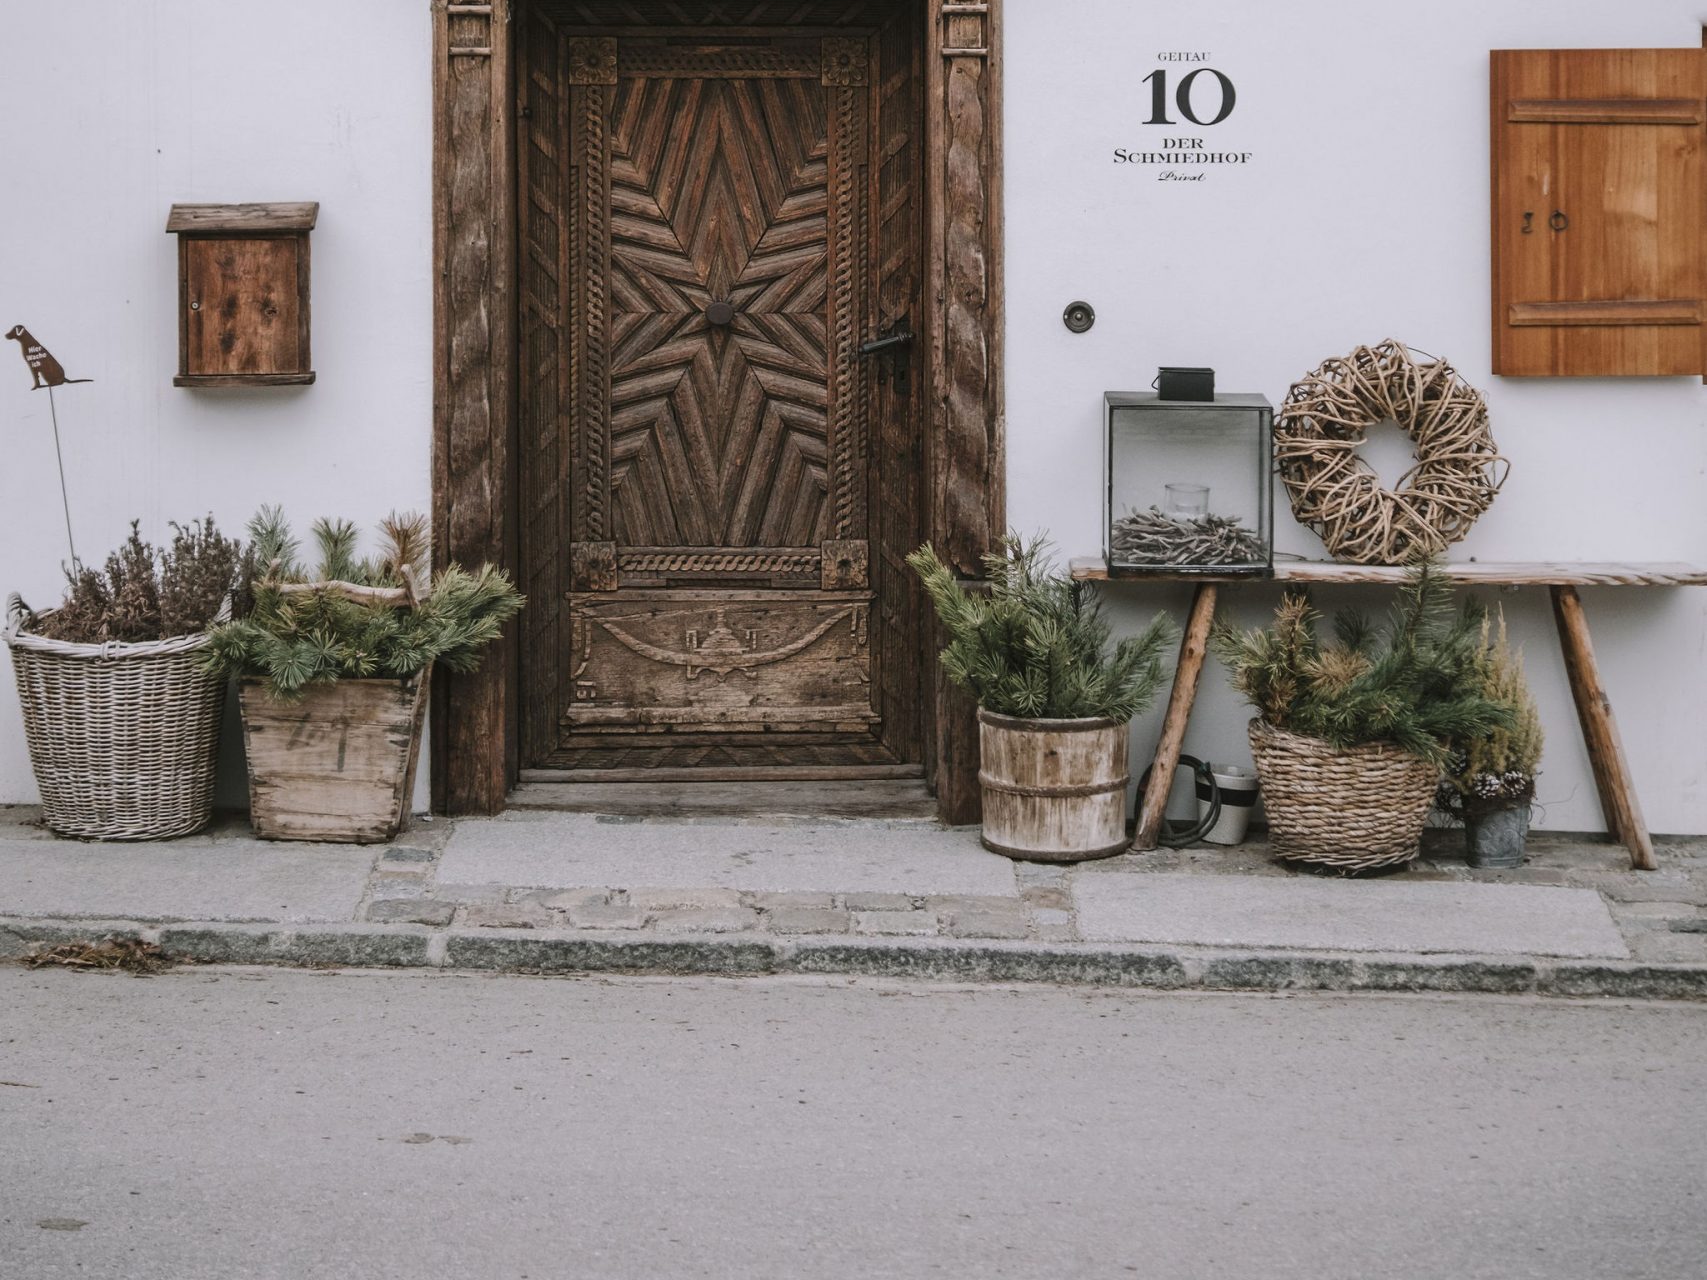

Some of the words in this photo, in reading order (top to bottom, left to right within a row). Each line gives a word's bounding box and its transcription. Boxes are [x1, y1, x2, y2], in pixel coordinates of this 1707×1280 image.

[1157, 52, 1212, 62] GEITAU
[1142, 68, 1237, 126] 10
[1163, 138, 1204, 149] DER
[1157, 170, 1206, 182] Privat
[26, 352, 47, 361] Wache
